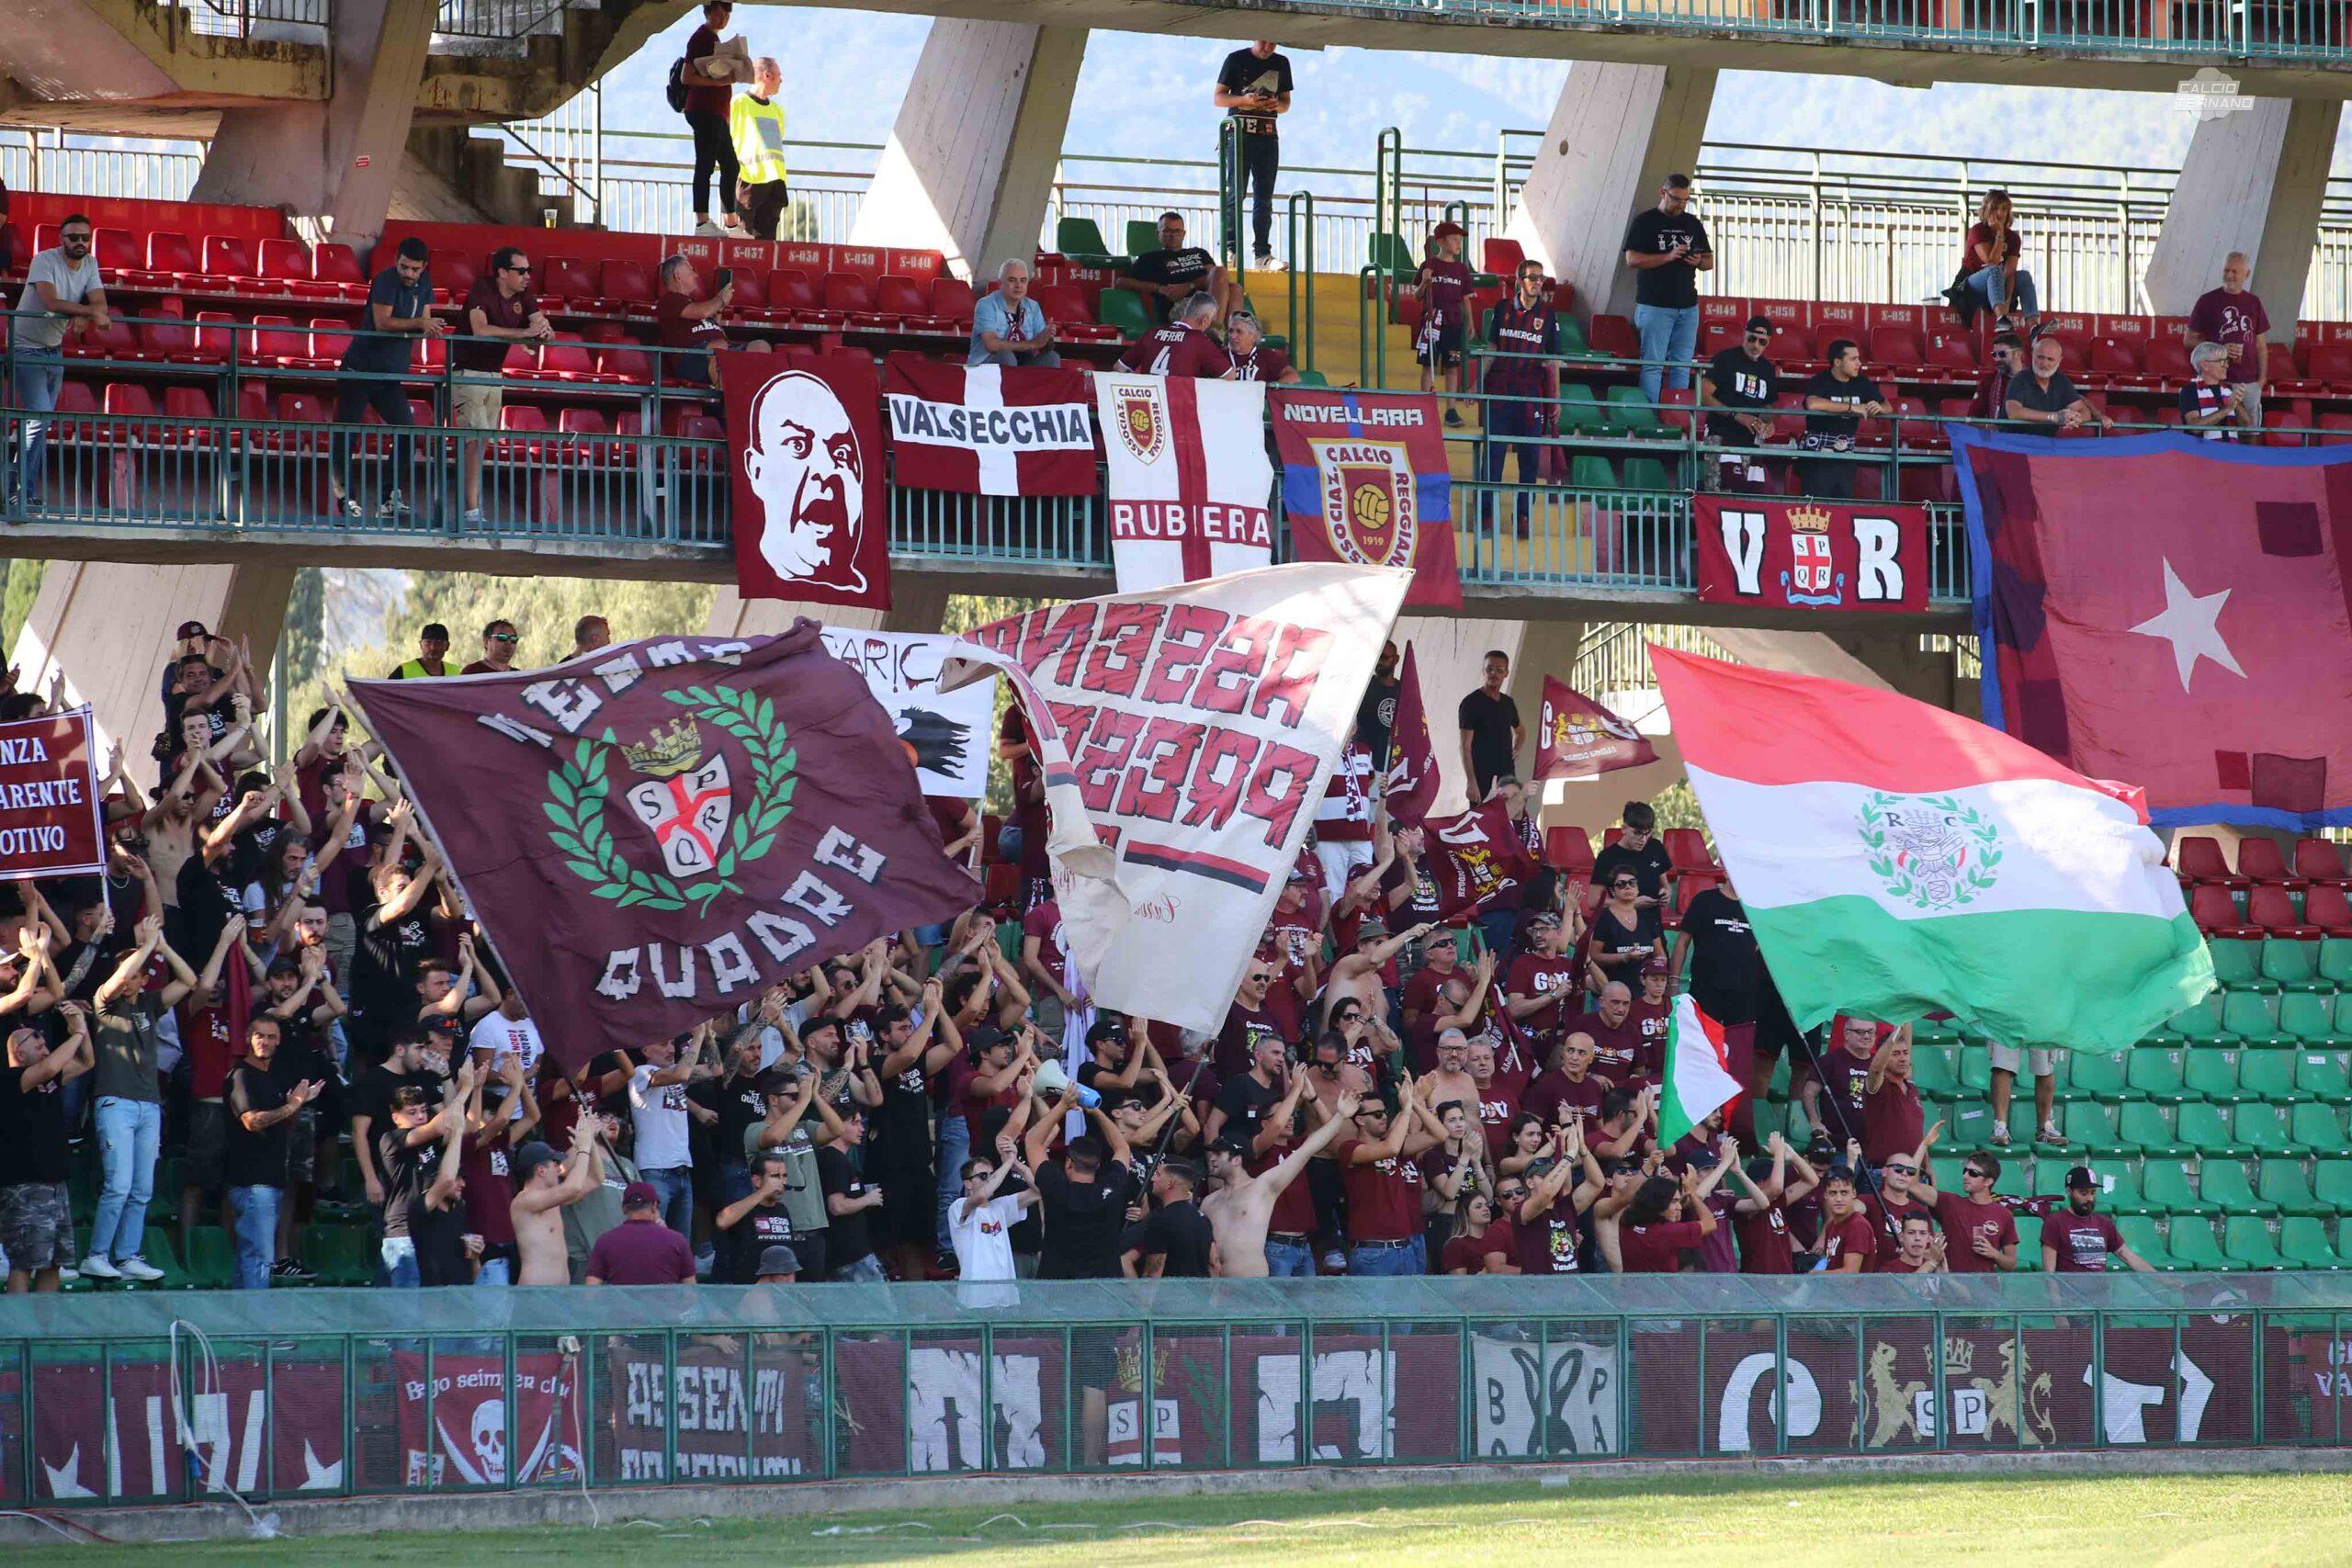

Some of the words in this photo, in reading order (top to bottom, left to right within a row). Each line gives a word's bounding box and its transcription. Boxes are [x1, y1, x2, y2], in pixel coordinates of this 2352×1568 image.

[1882, 310, 1912, 321] S-052
[1939, 311, 1962, 323] S-05
[1499, 328, 1544, 344] IMMERGAS
[1149, 345, 1171, 376] 4
[1118, 389, 1152, 399] CALCIO
[891, 399, 1091, 445] VALSECCHIA
[1148, 401, 1166, 457] REGGIANA
[1283, 403, 1424, 427] NOVELLARA
[1326, 446, 1394, 466] CALCIO
[1114, 503, 1272, 546] RUBIERA
[1327, 466, 1367, 565] SSOCIAZ.
[1385, 471, 1413, 569] REGGIAN
[1363, 536, 1385, 546] 1919
[1720, 510, 1767, 595] V
[1852, 517, 1905, 601] R
[1796, 538, 1805, 552] S
[1818, 540, 1826, 552] P
[1797, 568, 1808, 584] Q
[1818, 568, 1827, 582] R
[820, 633, 946, 689] ARIC
[639, 788, 662, 820] S
[694, 769, 718, 793] P
[675, 837, 703, 866] Q
[702, 804, 724, 833] R
[1885, 812, 1905, 828] R
[1944, 816, 1958, 827] C
[595, 824, 888, 1001] QUADRE
[1115, 1406, 1130, 1435] S
